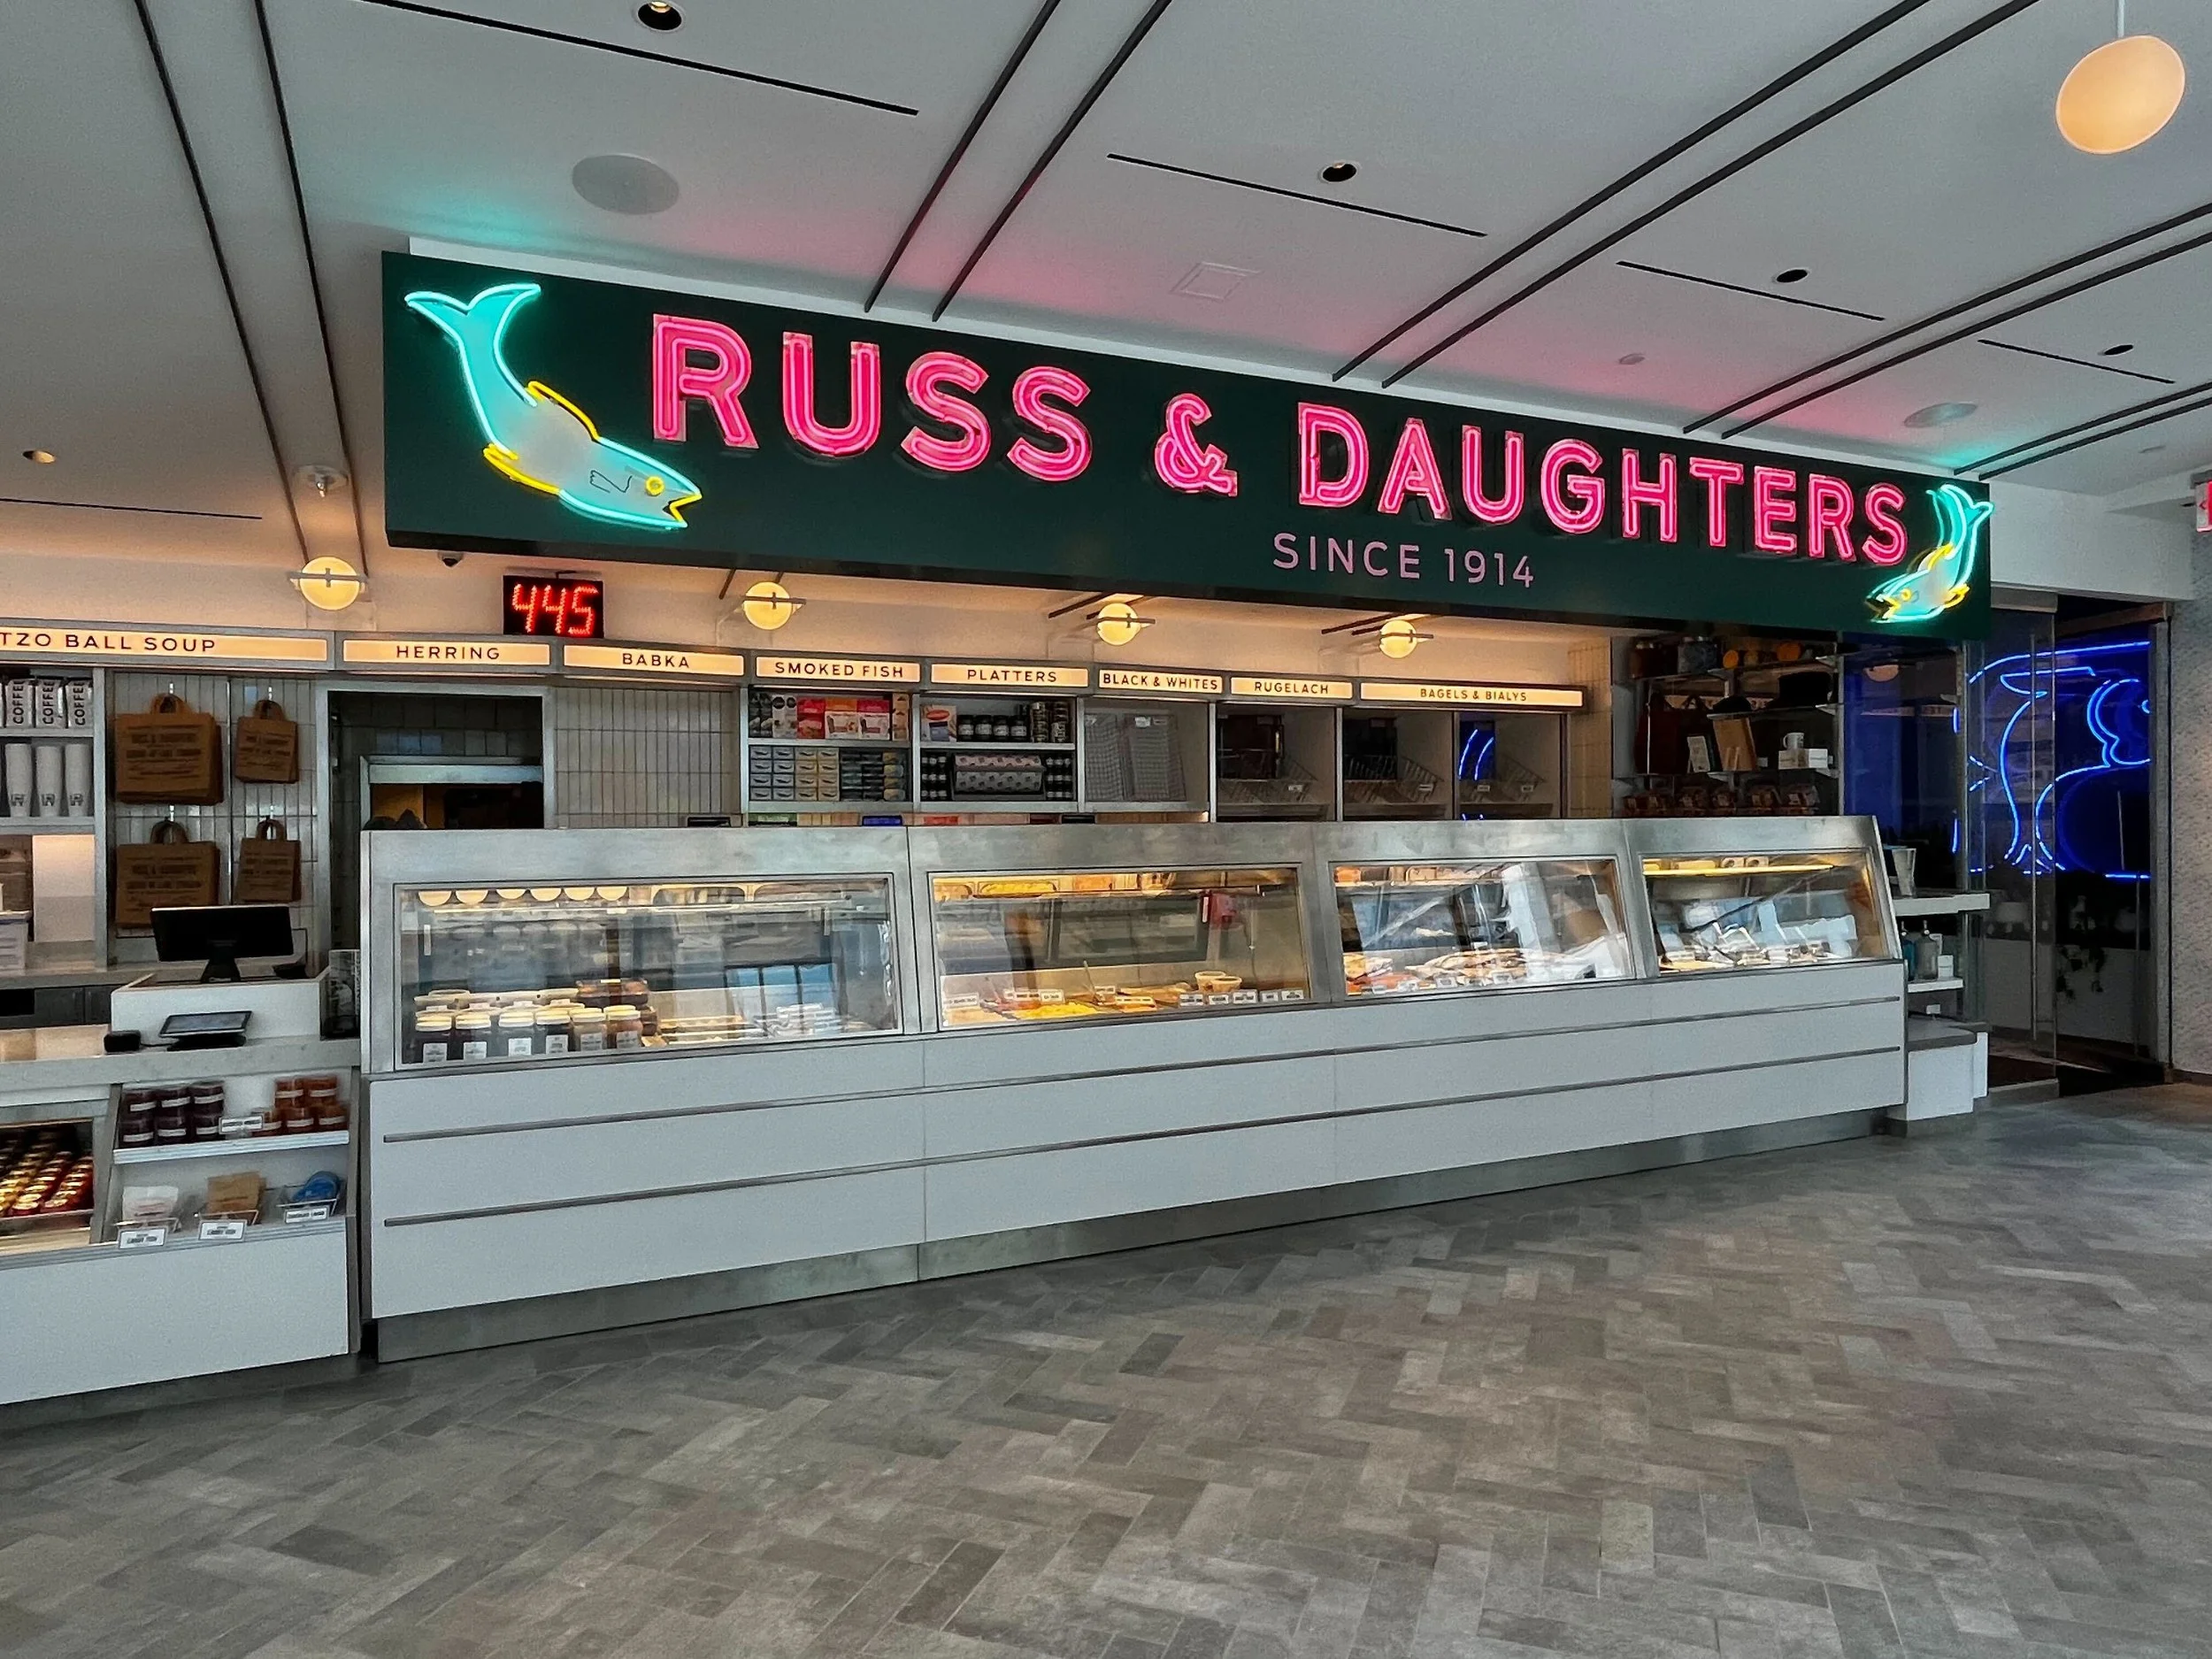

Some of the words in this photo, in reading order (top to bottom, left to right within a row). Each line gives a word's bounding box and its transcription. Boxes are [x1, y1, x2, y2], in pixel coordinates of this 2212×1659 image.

[652, 313, 1092, 482] RUSS
[1153, 392, 1239, 497] &
[1297, 401, 1908, 567] DAUGHTERS
[1272, 532, 1421, 580] SINCE
[1443, 548, 1535, 589] 1914
[511, 583, 599, 634] 445
[0, 632, 51, 647] TZO
[65, 634, 132, 650] BALL
[144, 638, 215, 652] SOUP
[396, 645, 501, 661] HERRING
[622, 652, 690, 669] BABKA
[775, 662, 855, 677] SMOKED
[863, 665, 903, 678] FISH
[967, 669, 1057, 682] PLATTERS
[1102, 672, 1148, 687] BLACK
[1153, 676, 1161, 687] &
[1166, 678, 1218, 690] WHITES
[1254, 681, 1329, 695] RUGELACH
[1419, 688, 1467, 699] BAGELS
[1472, 690, 1480, 700] &
[1486, 691, 1527, 702] BIALYS
